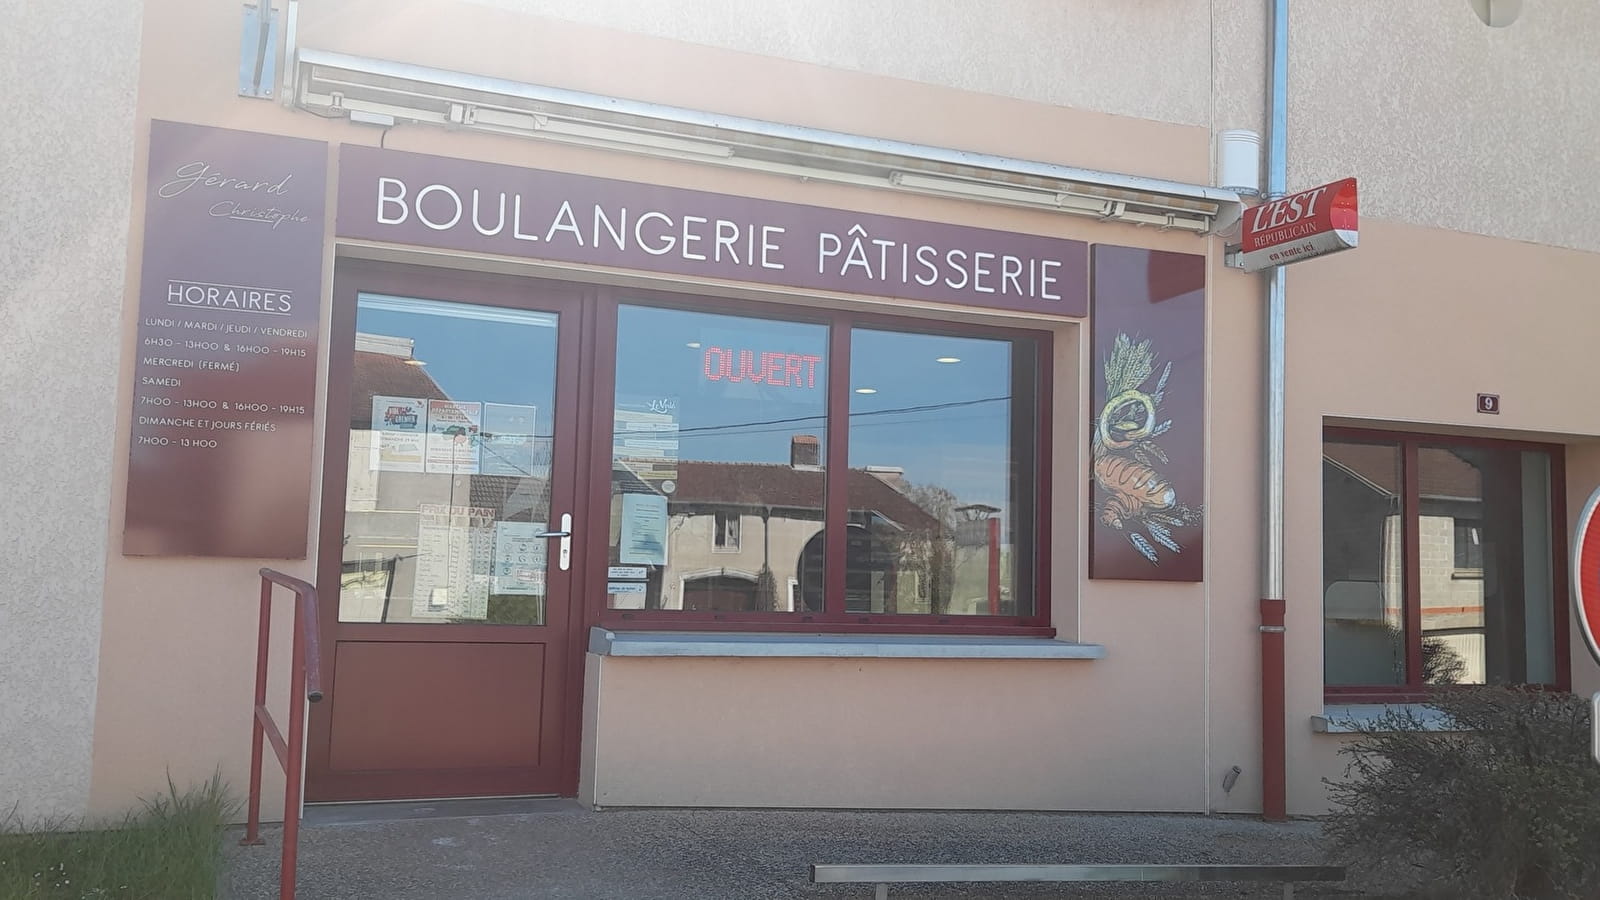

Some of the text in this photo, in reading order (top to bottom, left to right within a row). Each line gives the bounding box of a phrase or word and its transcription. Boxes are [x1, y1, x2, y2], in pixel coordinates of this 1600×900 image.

[158, 161, 293, 198] Gérard
[208, 200, 309, 230] Christophe
[1251, 187, 1327, 234] L'EST
[376, 177, 1062, 300] BOULANGERIE PÂTISSERIE
[1254, 221, 1317, 248] RÉPUBLICAIN
[1269, 242, 1314, 261] en vente ici
[167, 283, 292, 313] HORAIRES
[145, 318, 175, 328] LUNDI
[184, 320, 217, 331] MARDI
[225, 324, 251, 334] JEUDI
[260, 327, 308, 338] VENDREDI
[223, 343, 231, 352] &
[281, 347, 306, 358] 19H15
[143, 357, 240, 372] MERCREDI (FERMÉ)
[704, 346, 822, 389] OUVERT
[142, 376, 181, 387] SAMEDI
[222, 401, 229, 410] &
[280, 405, 305, 414] 19H15
[1485, 397, 1493, 410] 9
[139, 416, 276, 432] DIMANCHE ET JOURS FÉRIÉS
